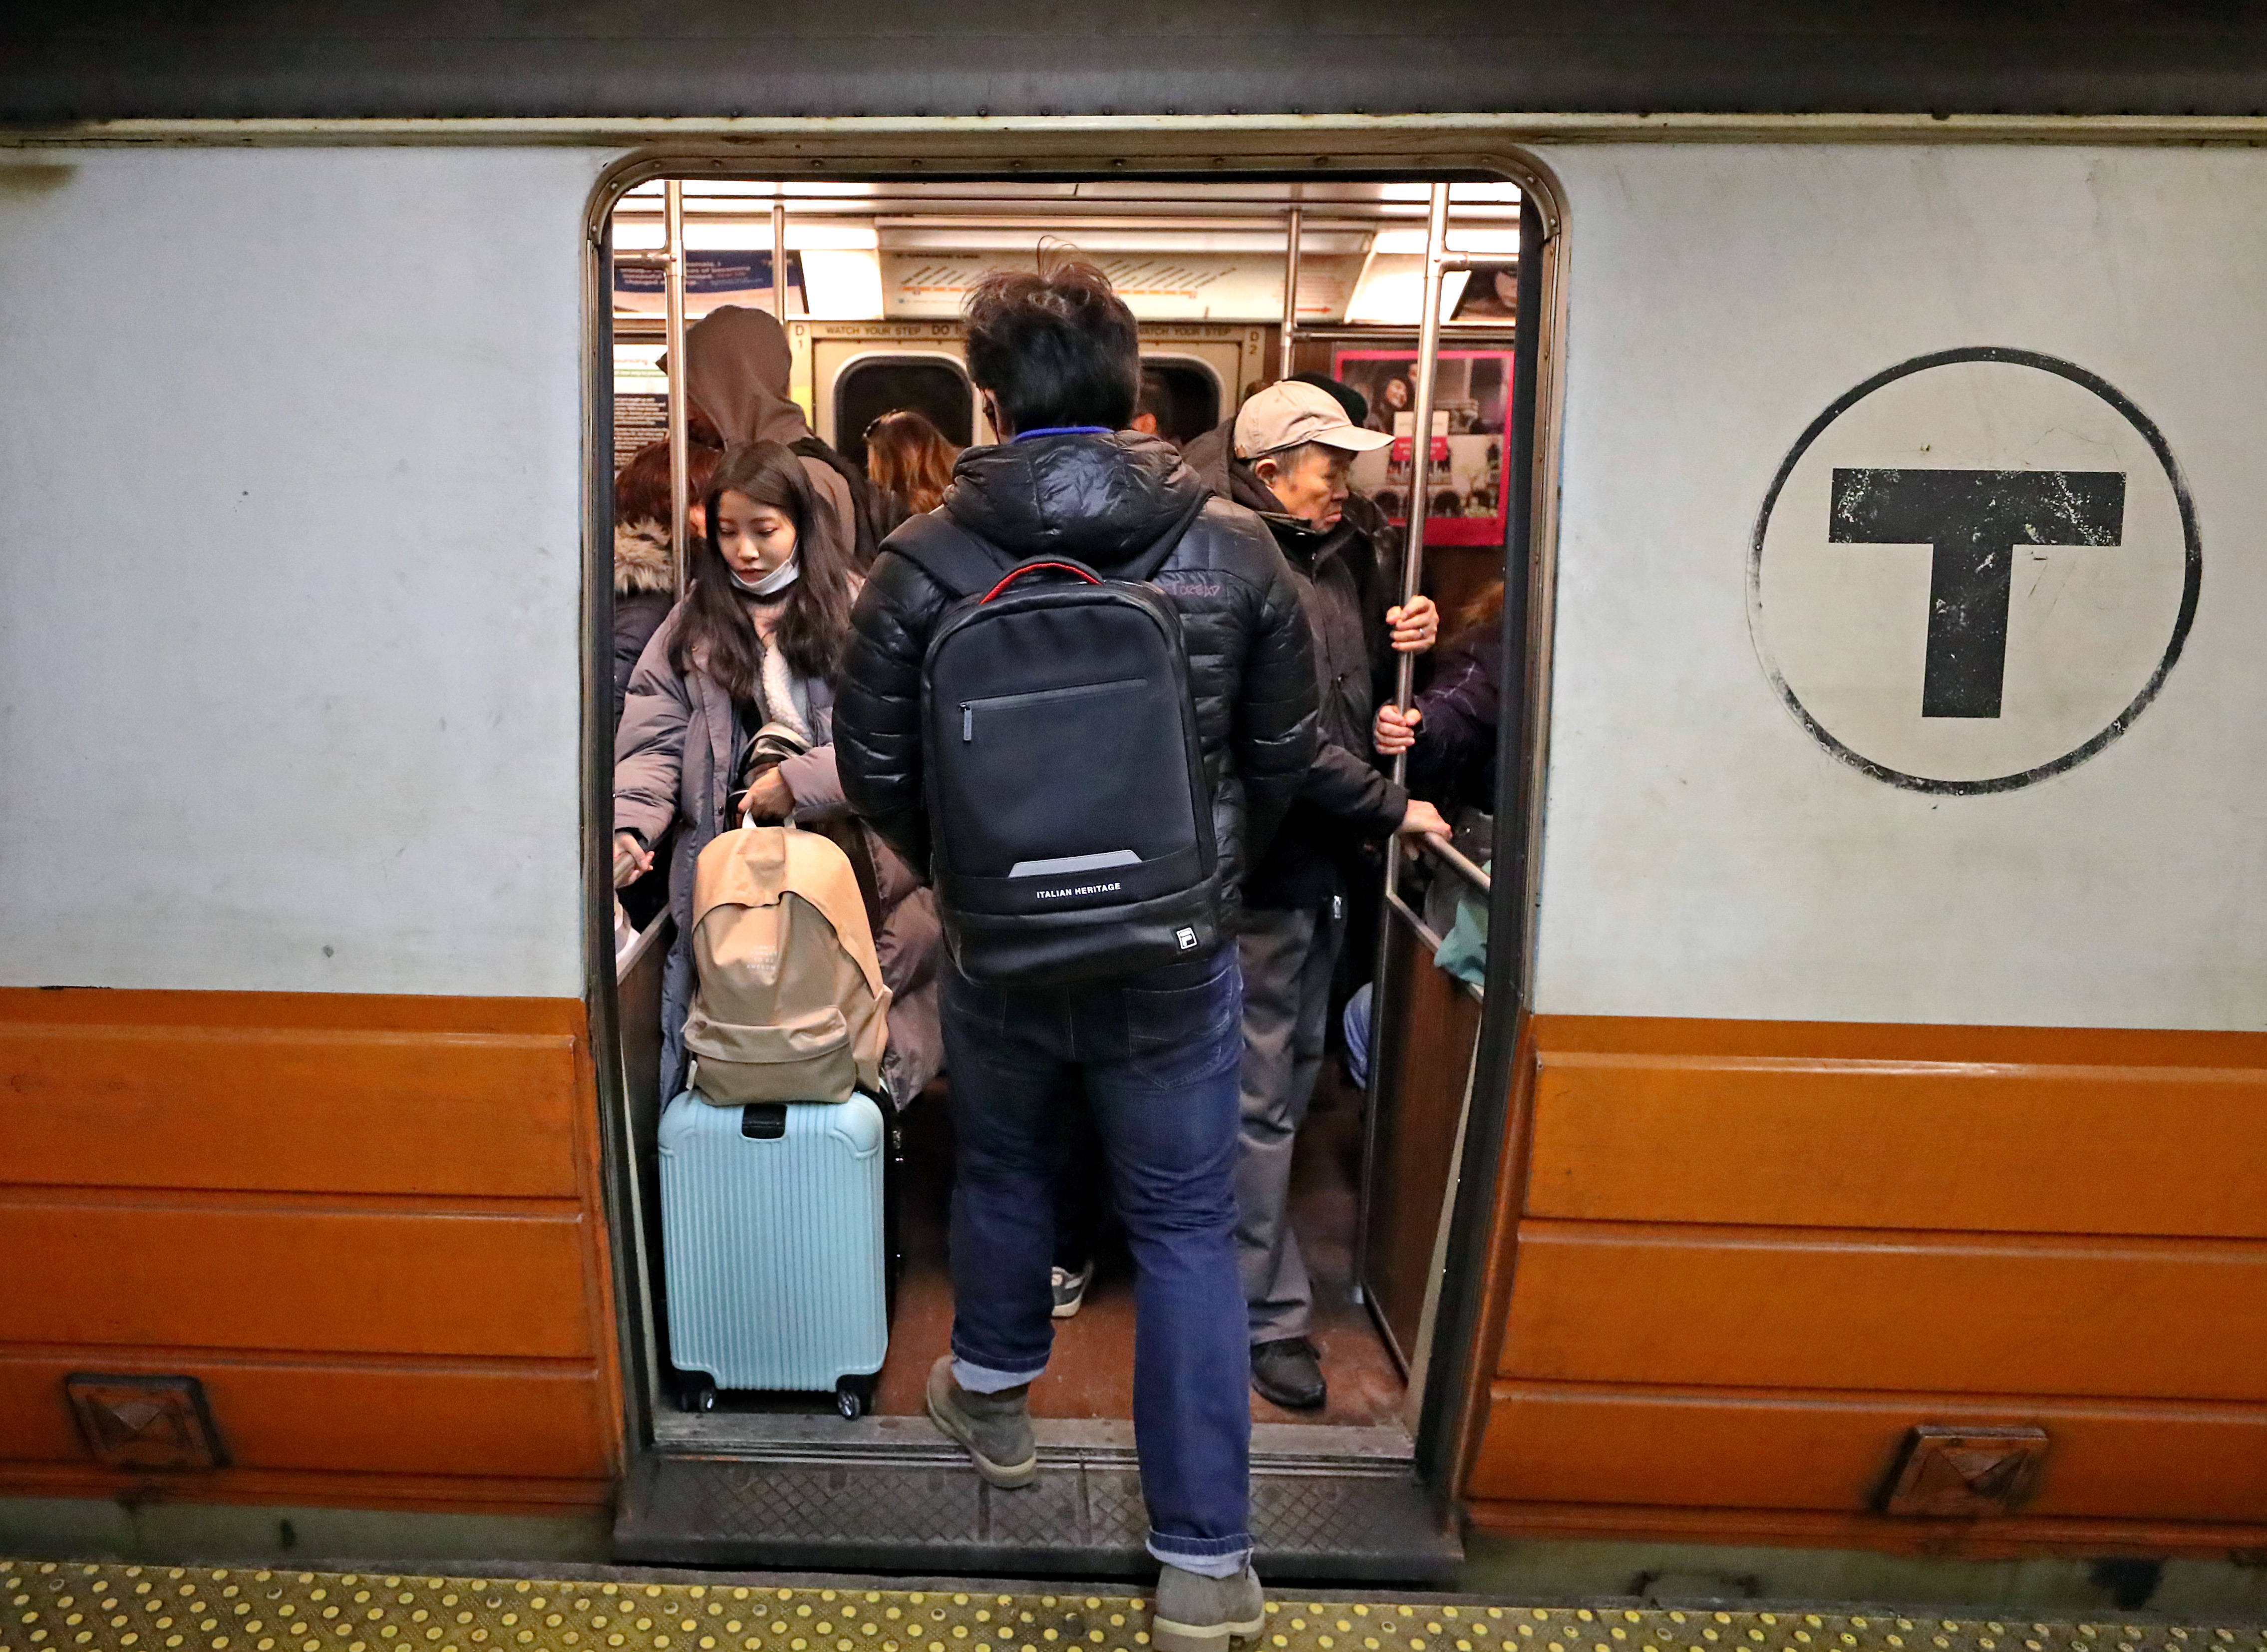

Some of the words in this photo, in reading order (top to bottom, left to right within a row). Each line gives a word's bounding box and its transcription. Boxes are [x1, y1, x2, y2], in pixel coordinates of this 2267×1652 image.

[795, 326, 804, 336] D
[865, 326, 891, 335] YOUR
[895, 326, 921, 335] STEP
[931, 325, 950, 335] DO
[1250, 330, 1260, 342] D
[1249, 344, 1258, 354] 2
[1829, 468, 2127, 718] T
[1036, 888, 1072, 899] ITALIAN
[1074, 882, 1121, 895] HERITAGE
